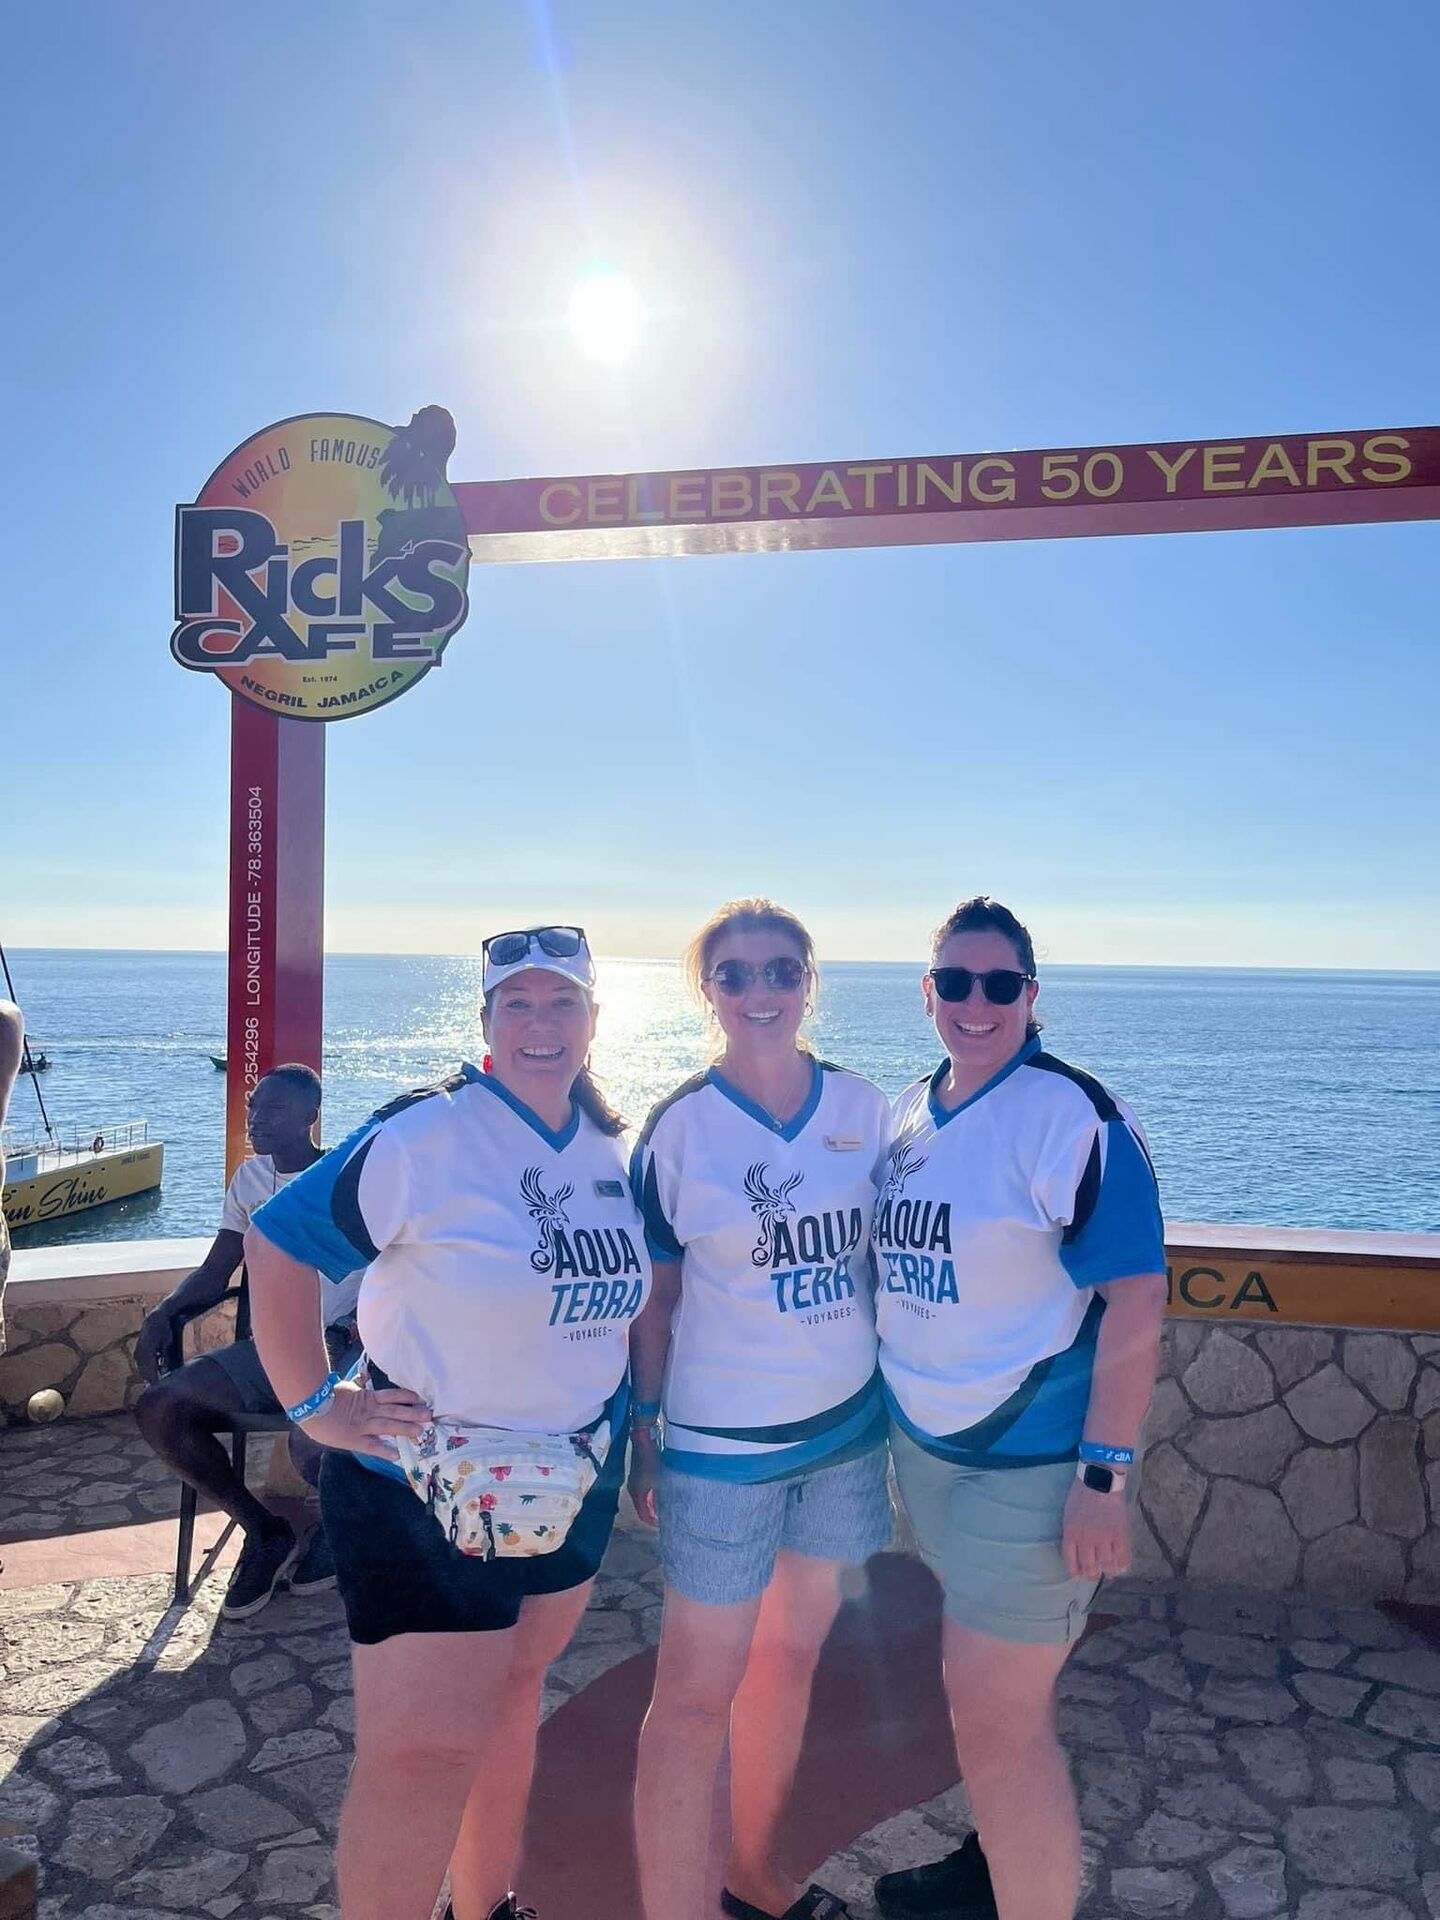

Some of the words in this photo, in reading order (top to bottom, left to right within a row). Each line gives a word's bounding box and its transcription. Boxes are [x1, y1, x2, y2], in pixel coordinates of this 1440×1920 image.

[232, 447, 290, 498] WORLD
[311, 438, 380, 469] FAMOUS
[539, 459, 1016, 525] CELEBRATING
[1040, 452, 1124, 499] 50
[1146, 436, 1412, 493] YEARS
[174, 621, 434, 662] CAFE
[240, 675, 308, 708] NEGRIL
[317, 670, 404, 708] JAMAICA
[302, 676, 317, 684] Est.
[320, 675, 338, 683] 1974
[247, 786, 262, 886] -78.363504
[246, 891, 262, 1005] LONGITUDE
[37, 1177, 109, 1217] Shine
[879, 1199, 952, 1254] AQUA
[554, 1228, 641, 1279] AQUA
[549, 1279, 643, 1326] TERRA
[294, 1403, 312, 1418] VIP
[1114, 1452, 1131, 1462] VIP
